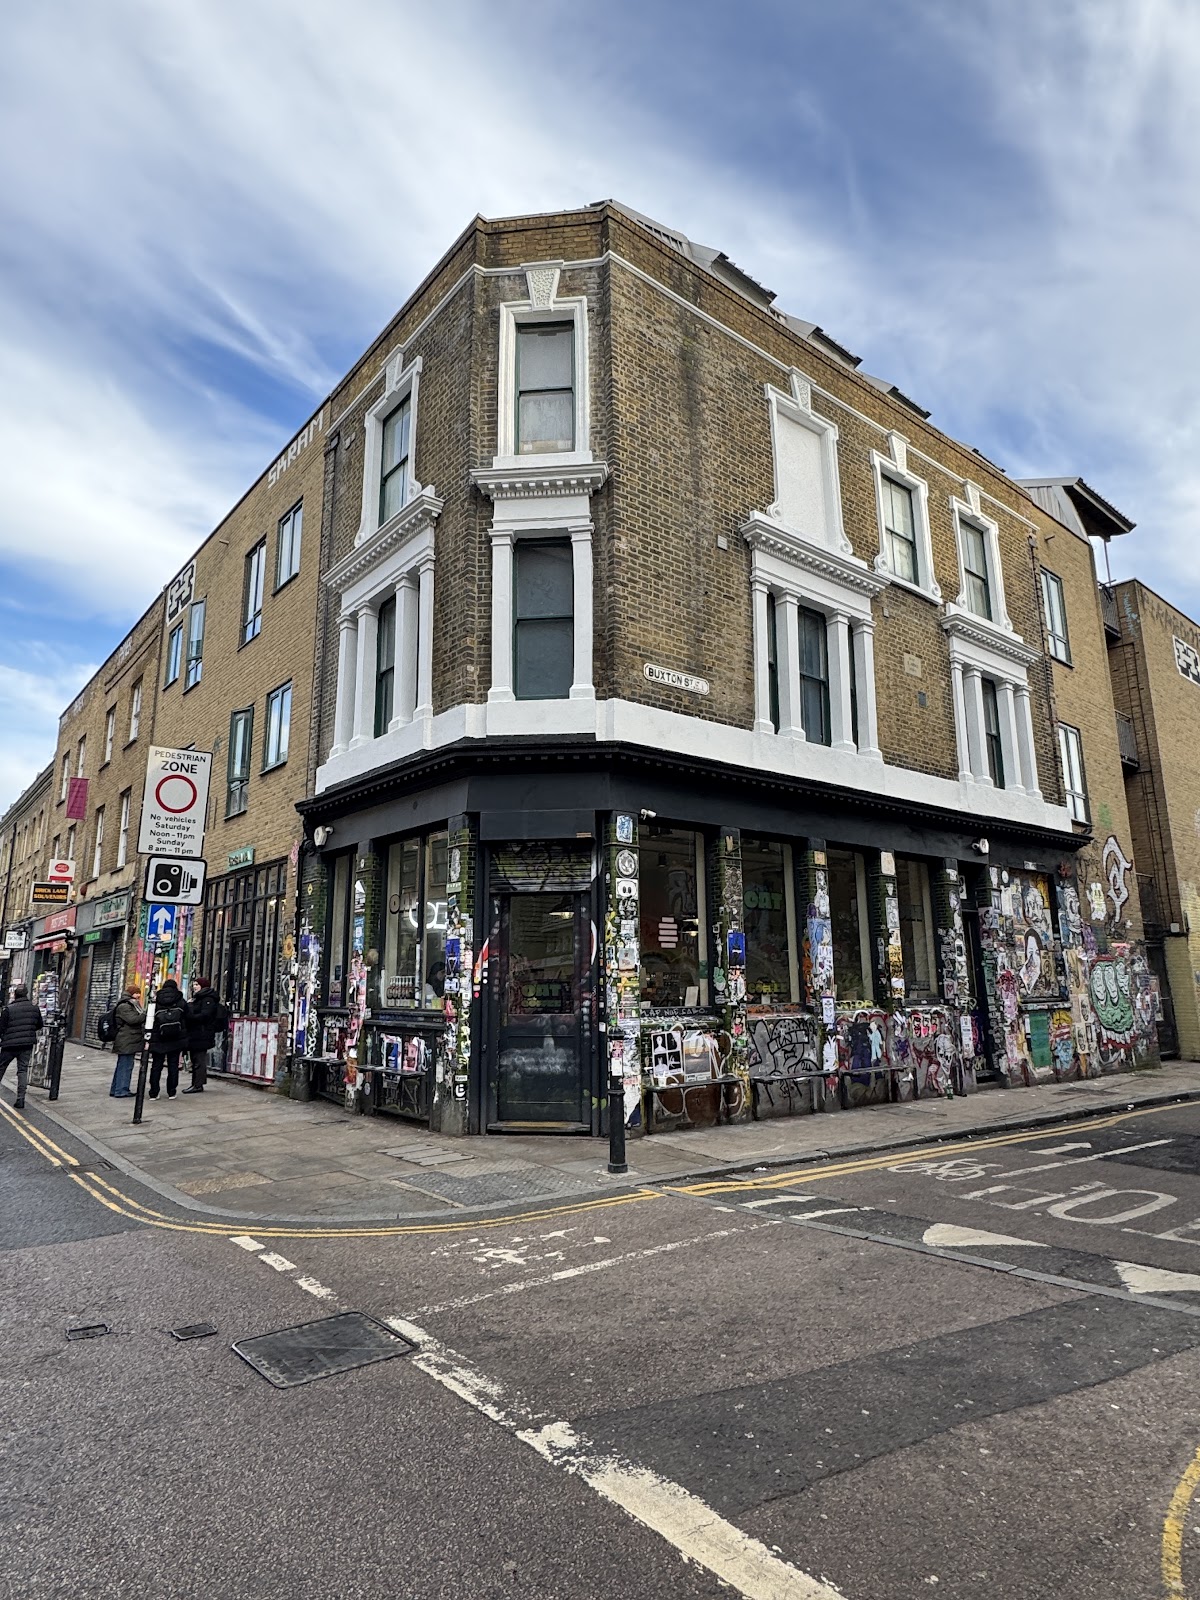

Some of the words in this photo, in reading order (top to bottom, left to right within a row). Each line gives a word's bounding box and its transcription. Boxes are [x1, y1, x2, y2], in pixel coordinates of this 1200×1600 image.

[648, 667, 683, 686] BUXTON
[154, 750, 206, 763] PEDESTRIAN
[160, 760, 198, 774] ZONE
[150, 813, 161, 821] No
[164, 815, 196, 824] vehicles
[149, 829, 170, 838] Noon
[155, 822, 190, 832] Saturday
[156, 838, 185, 847] Sunday
[743, 890, 783, 911] OAT
[521, 983, 562, 998] OAT
